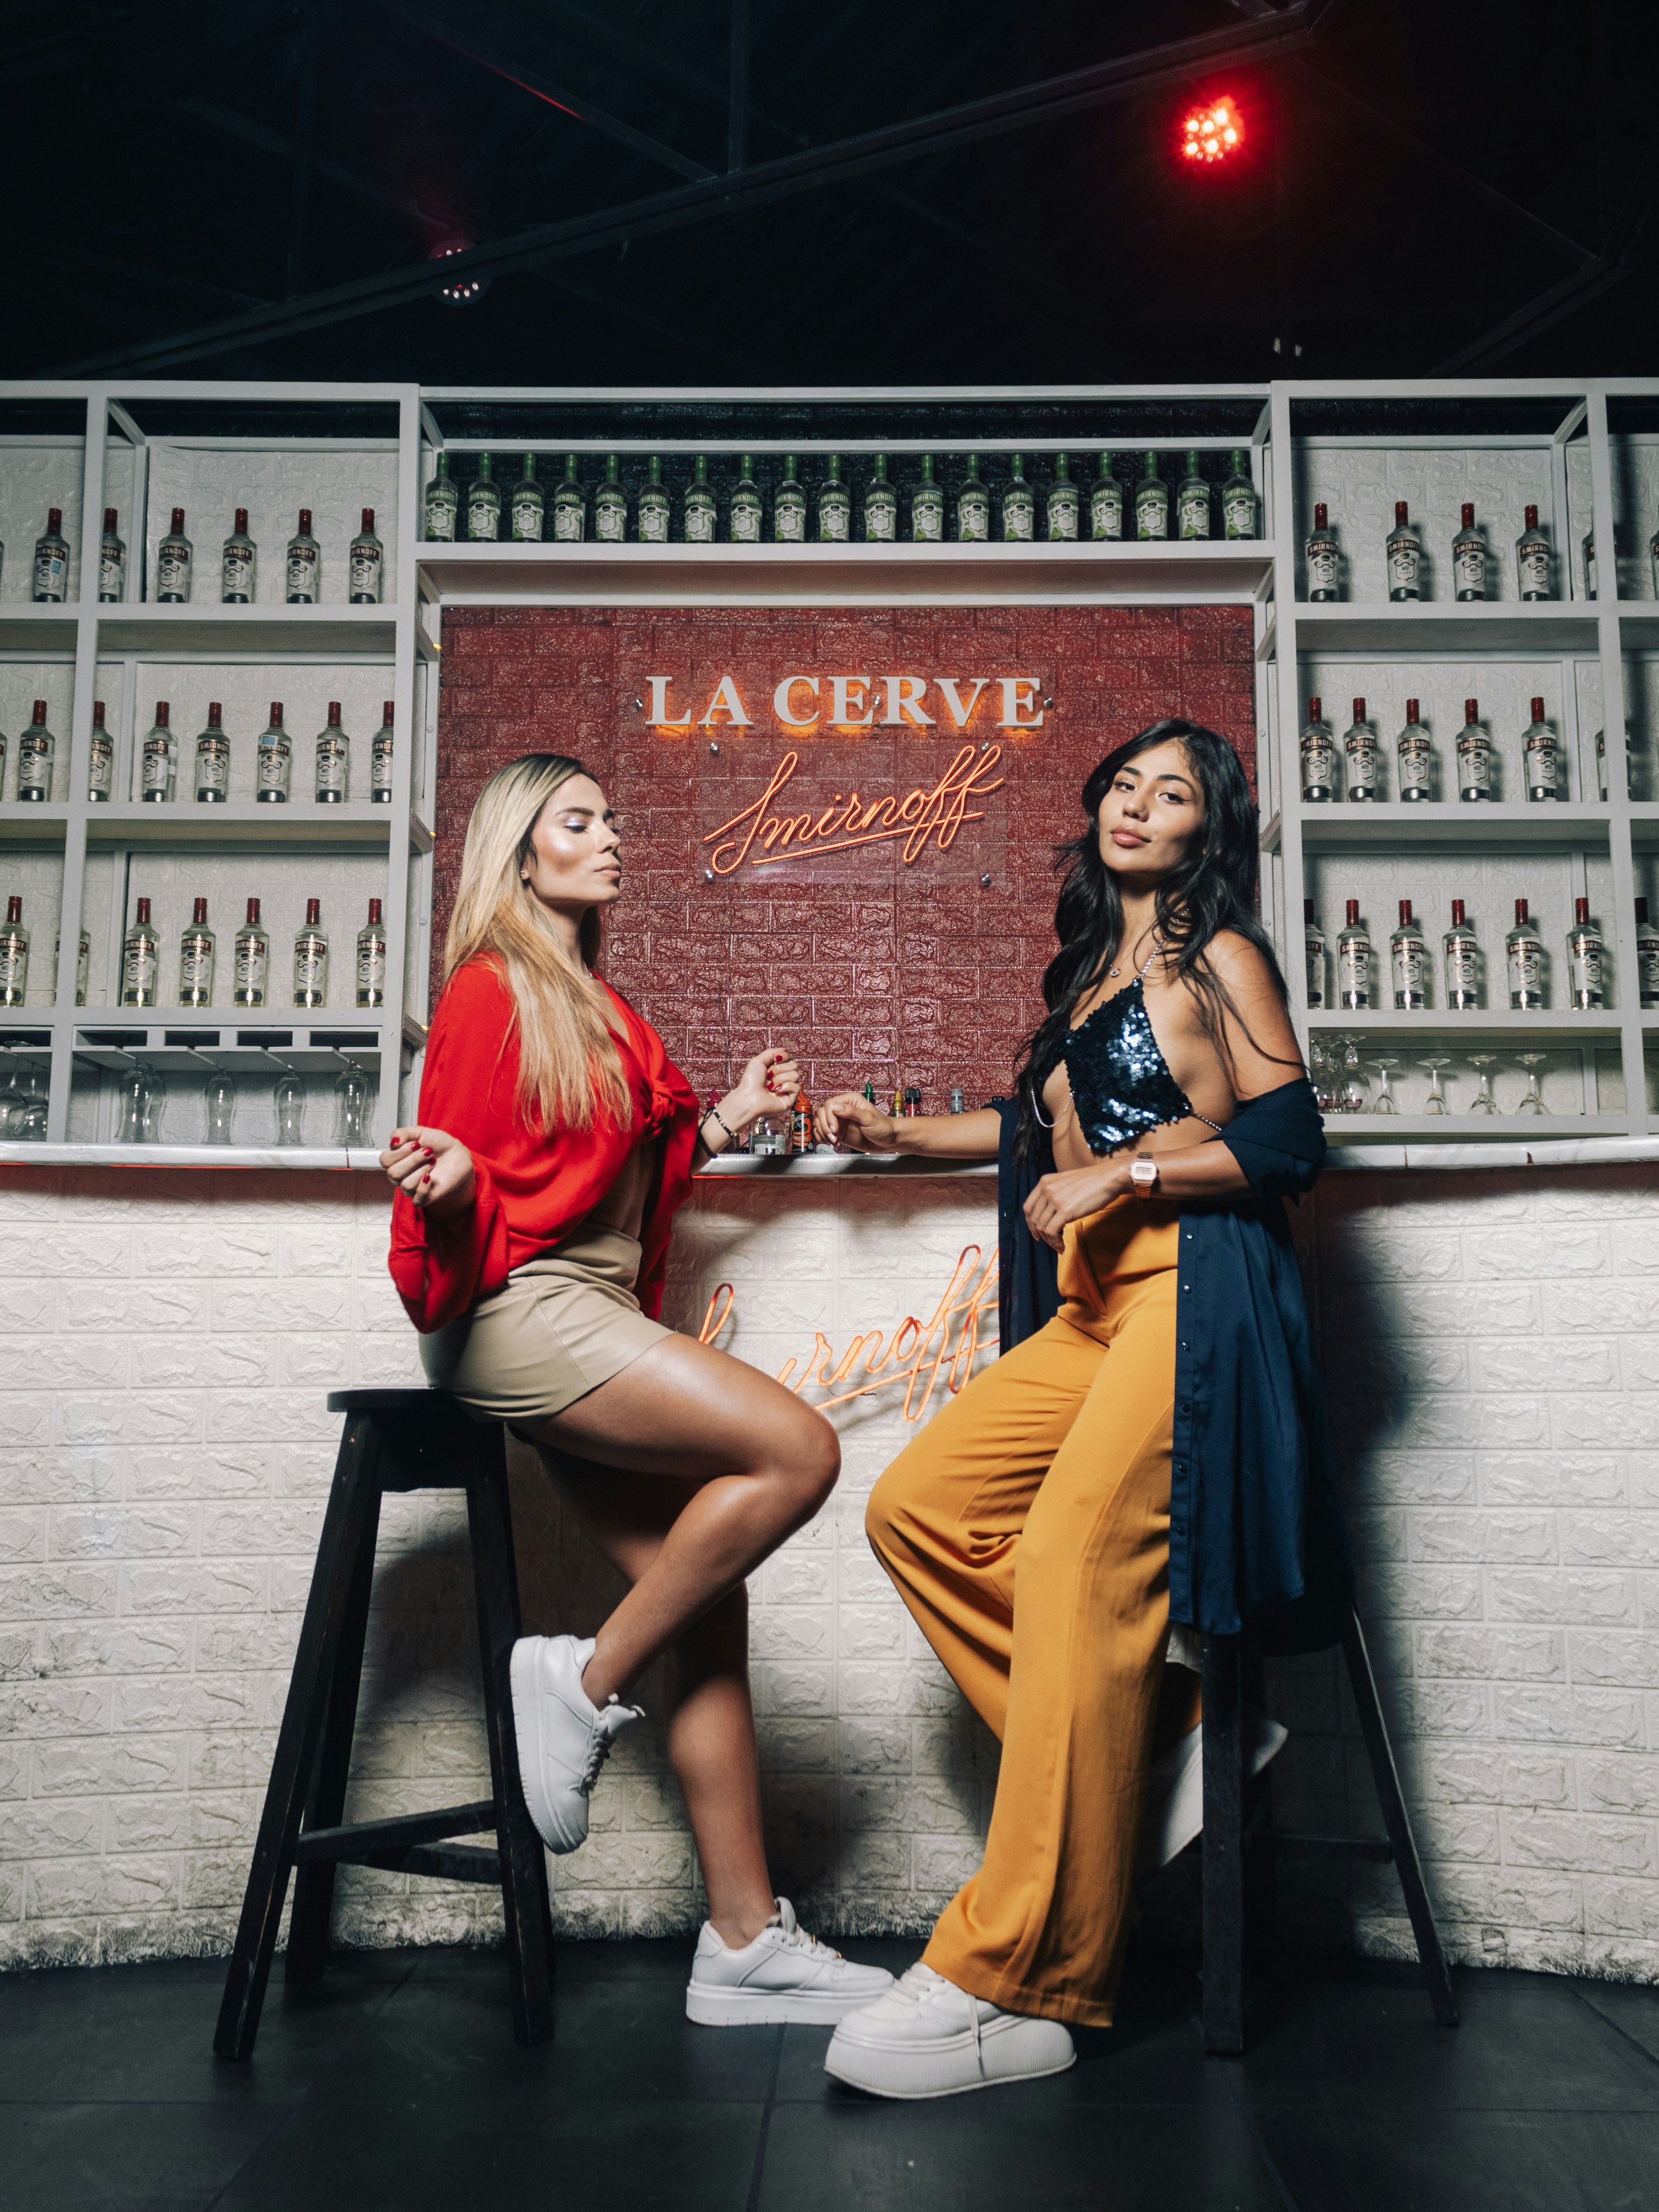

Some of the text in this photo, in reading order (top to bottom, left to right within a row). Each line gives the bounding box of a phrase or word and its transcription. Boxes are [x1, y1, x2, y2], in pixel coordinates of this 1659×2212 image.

[915, 494, 941, 503] SMIRNOF
[1006, 493, 1031, 502] SMIRNOF
[102, 548, 118, 557] NOFF
[645, 675, 1044, 727] LA CERVE
[703, 745, 1005, 874] Smirnoff
